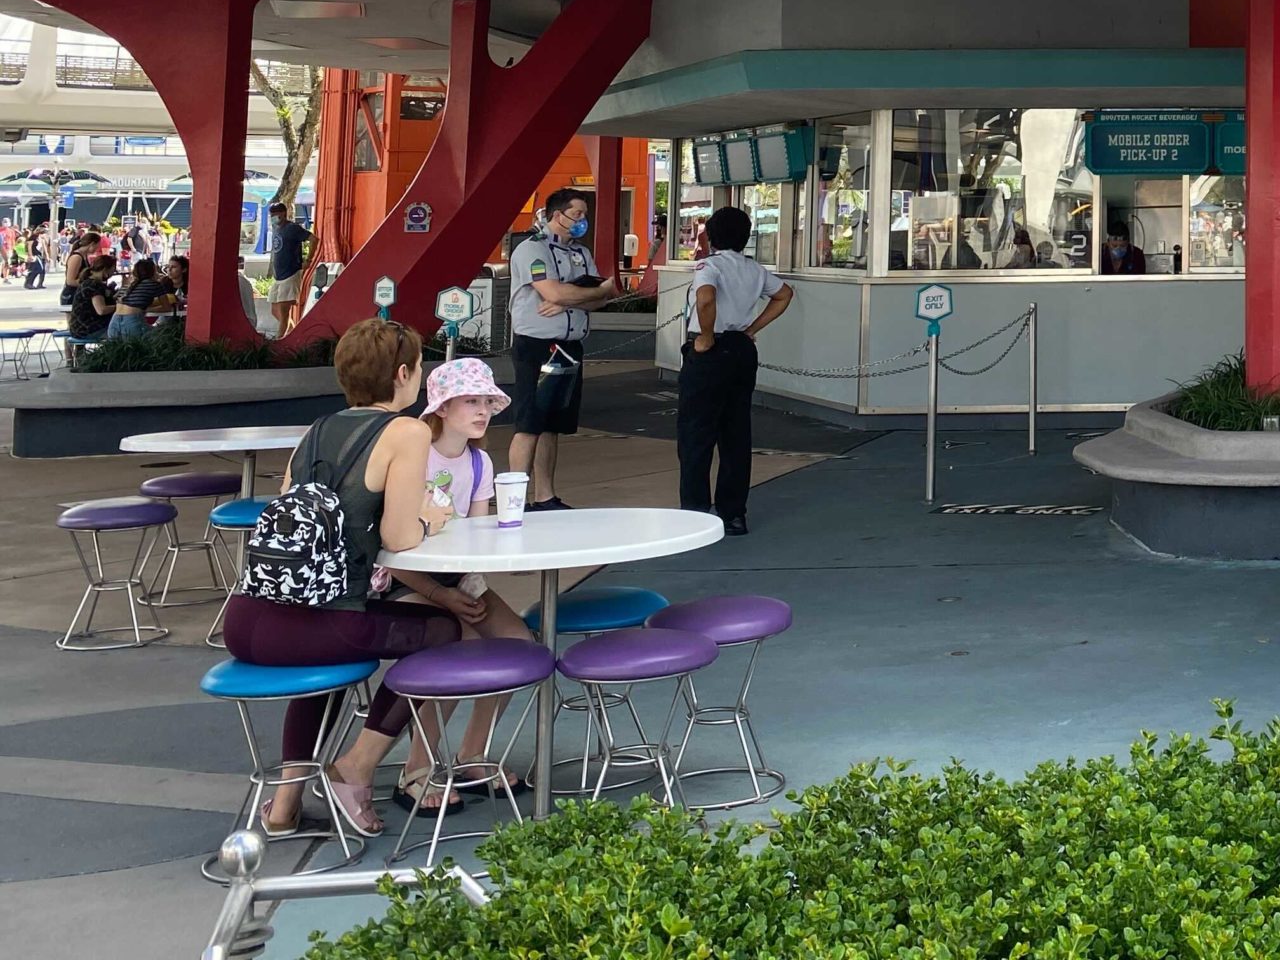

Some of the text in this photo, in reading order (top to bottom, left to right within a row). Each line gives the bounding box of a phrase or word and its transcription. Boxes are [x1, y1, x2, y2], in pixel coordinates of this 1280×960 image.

[1108, 134, 1190, 146] MOBILE ORDER
[1120, 149, 1179, 161] PICK-UP 2
[1070, 234, 1087, 256] 2
[925, 294, 944, 302] EXIT
[924, 302, 945, 311] ONLY
[1015, 507, 1094, 515] ONLY
